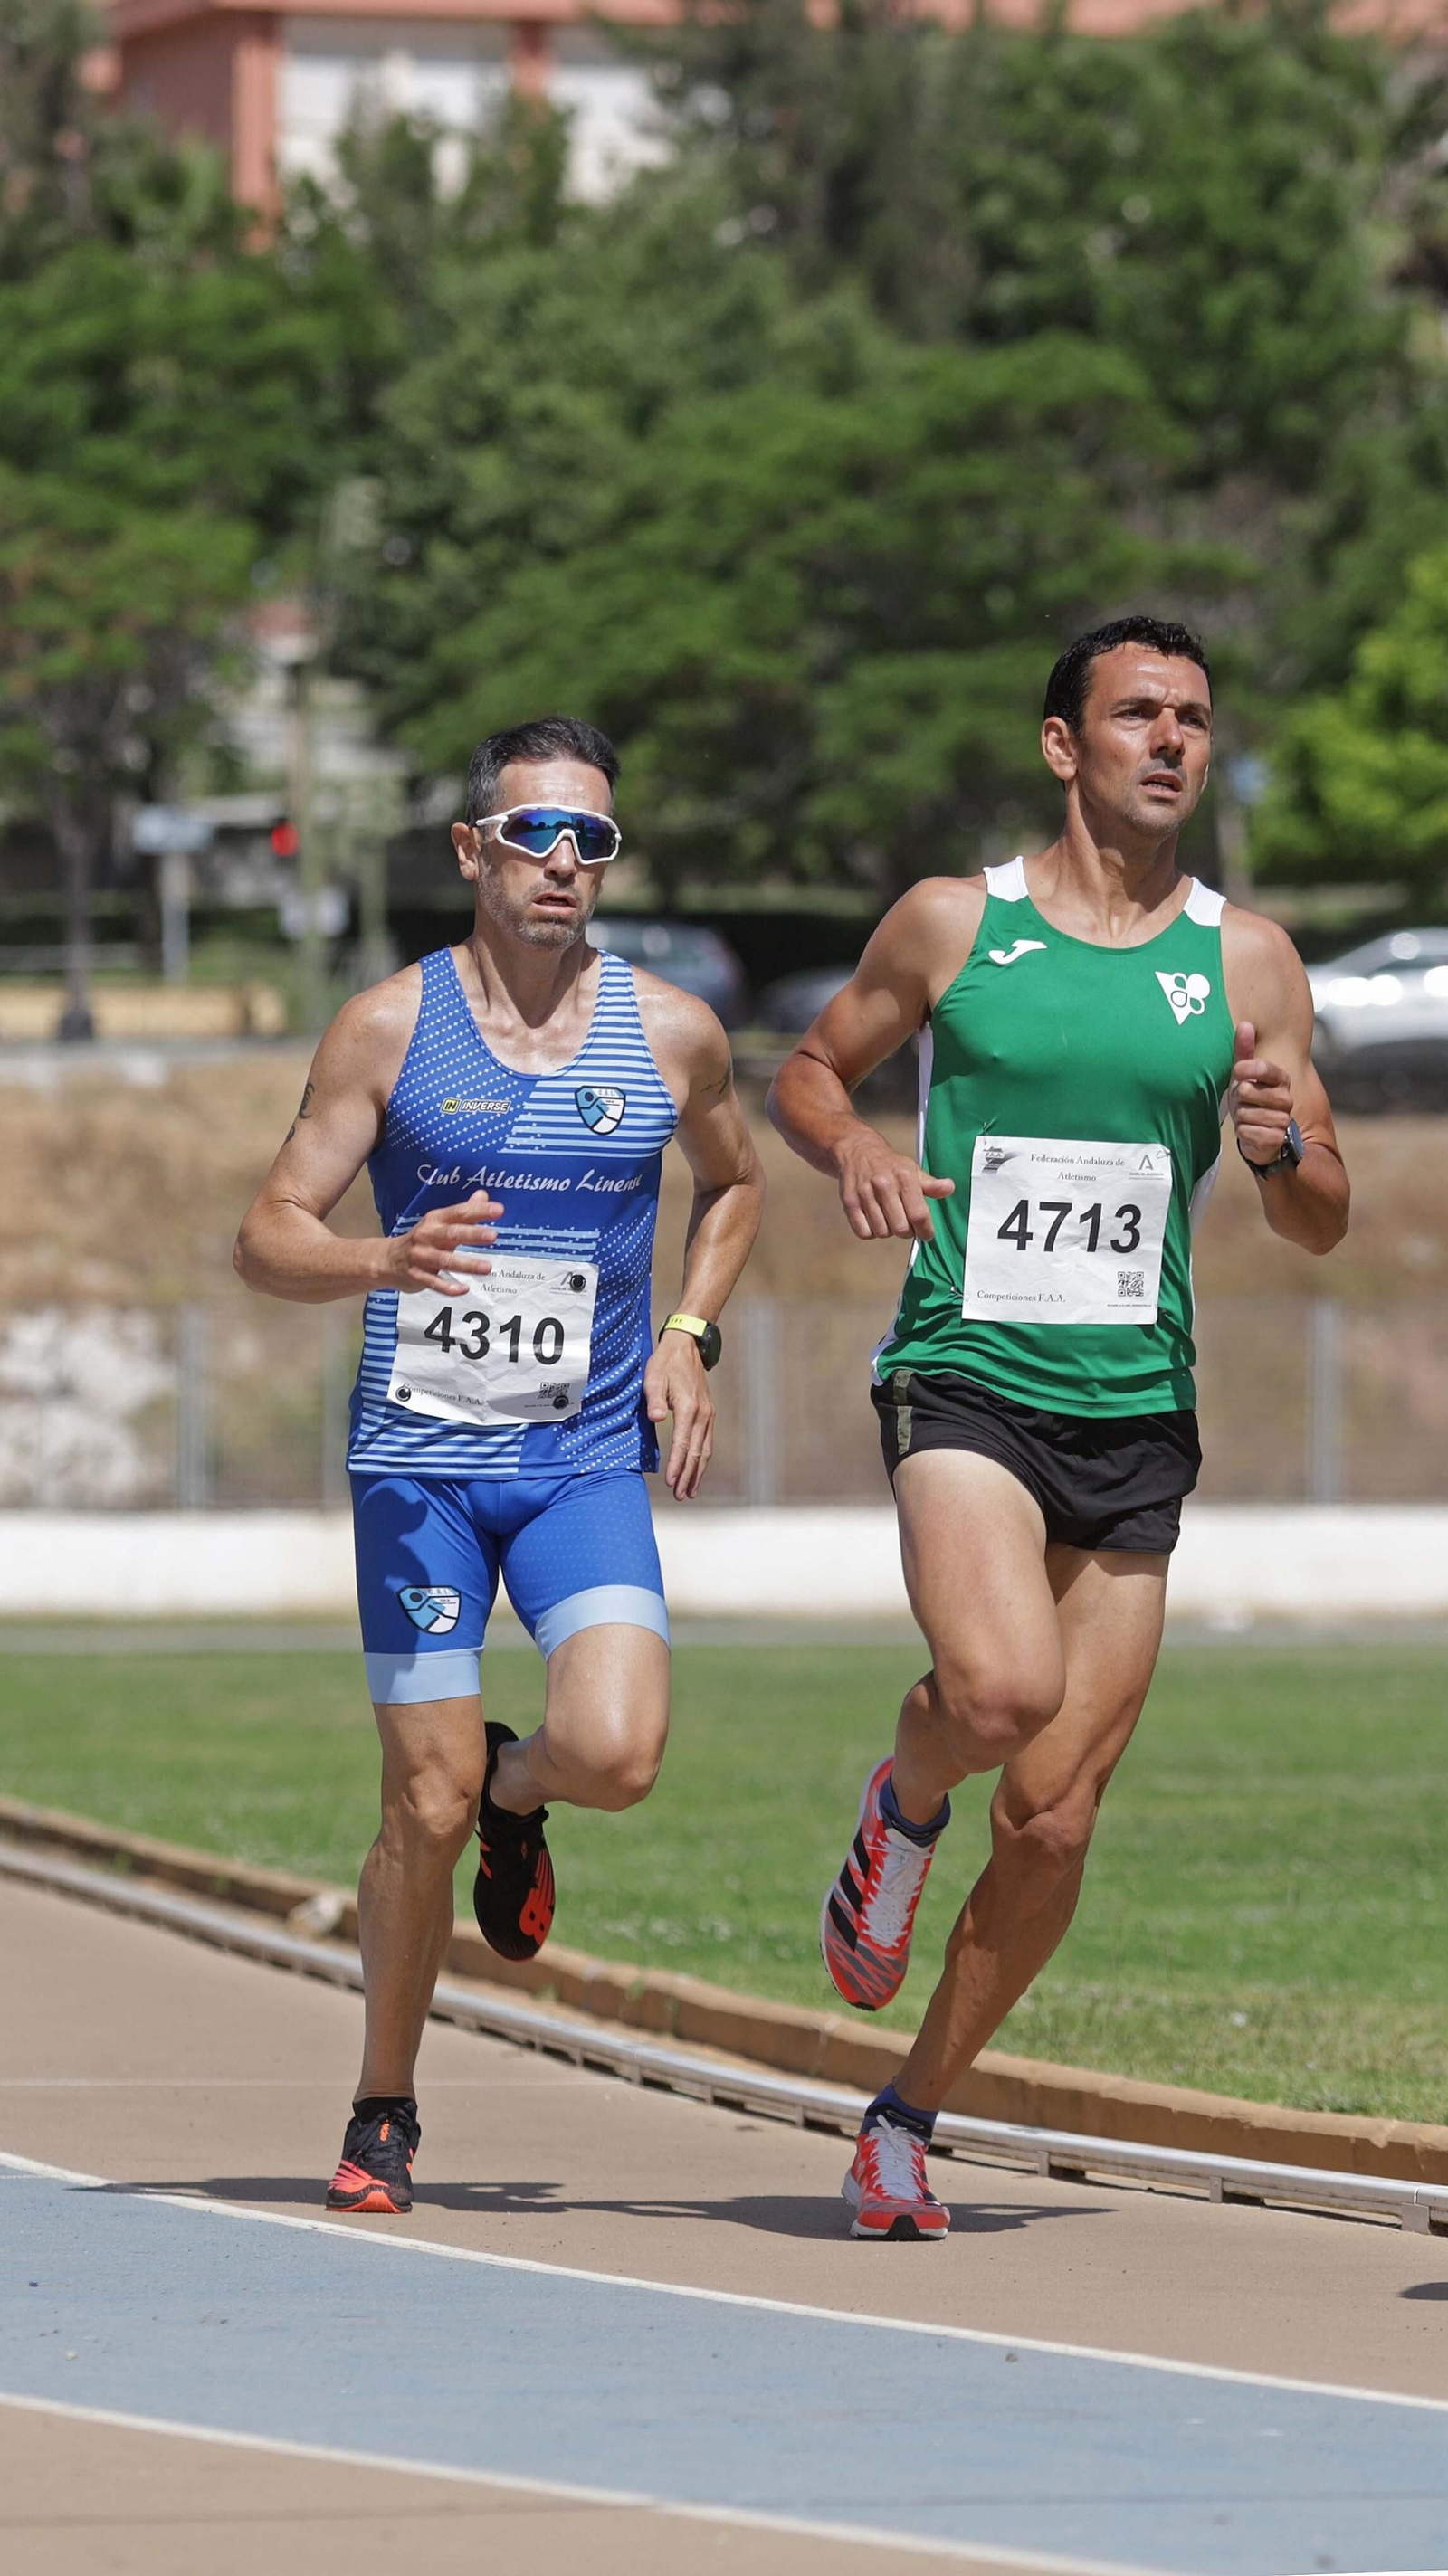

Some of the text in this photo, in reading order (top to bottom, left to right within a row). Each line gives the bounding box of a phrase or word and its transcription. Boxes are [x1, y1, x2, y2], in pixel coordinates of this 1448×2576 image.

[462, 1100, 509, 1111] INVERSE
[1031, 1154, 1124, 1166] Federación Andaluza de
[417, 1164, 460, 1186] Club
[462, 1165, 571, 1192] Atletismo
[1057, 1172, 1096, 1182] Atletismo
[997, 1199, 1142, 1254] 4713
[499, 1269, 534, 1280] Andaluza
[536, 1273, 545, 1281] de
[480, 1283, 518, 1295] Atletismo
[977, 1290, 1066, 1303] Competiciones F.A.A.
[424, 1306, 565, 1365] 4310
